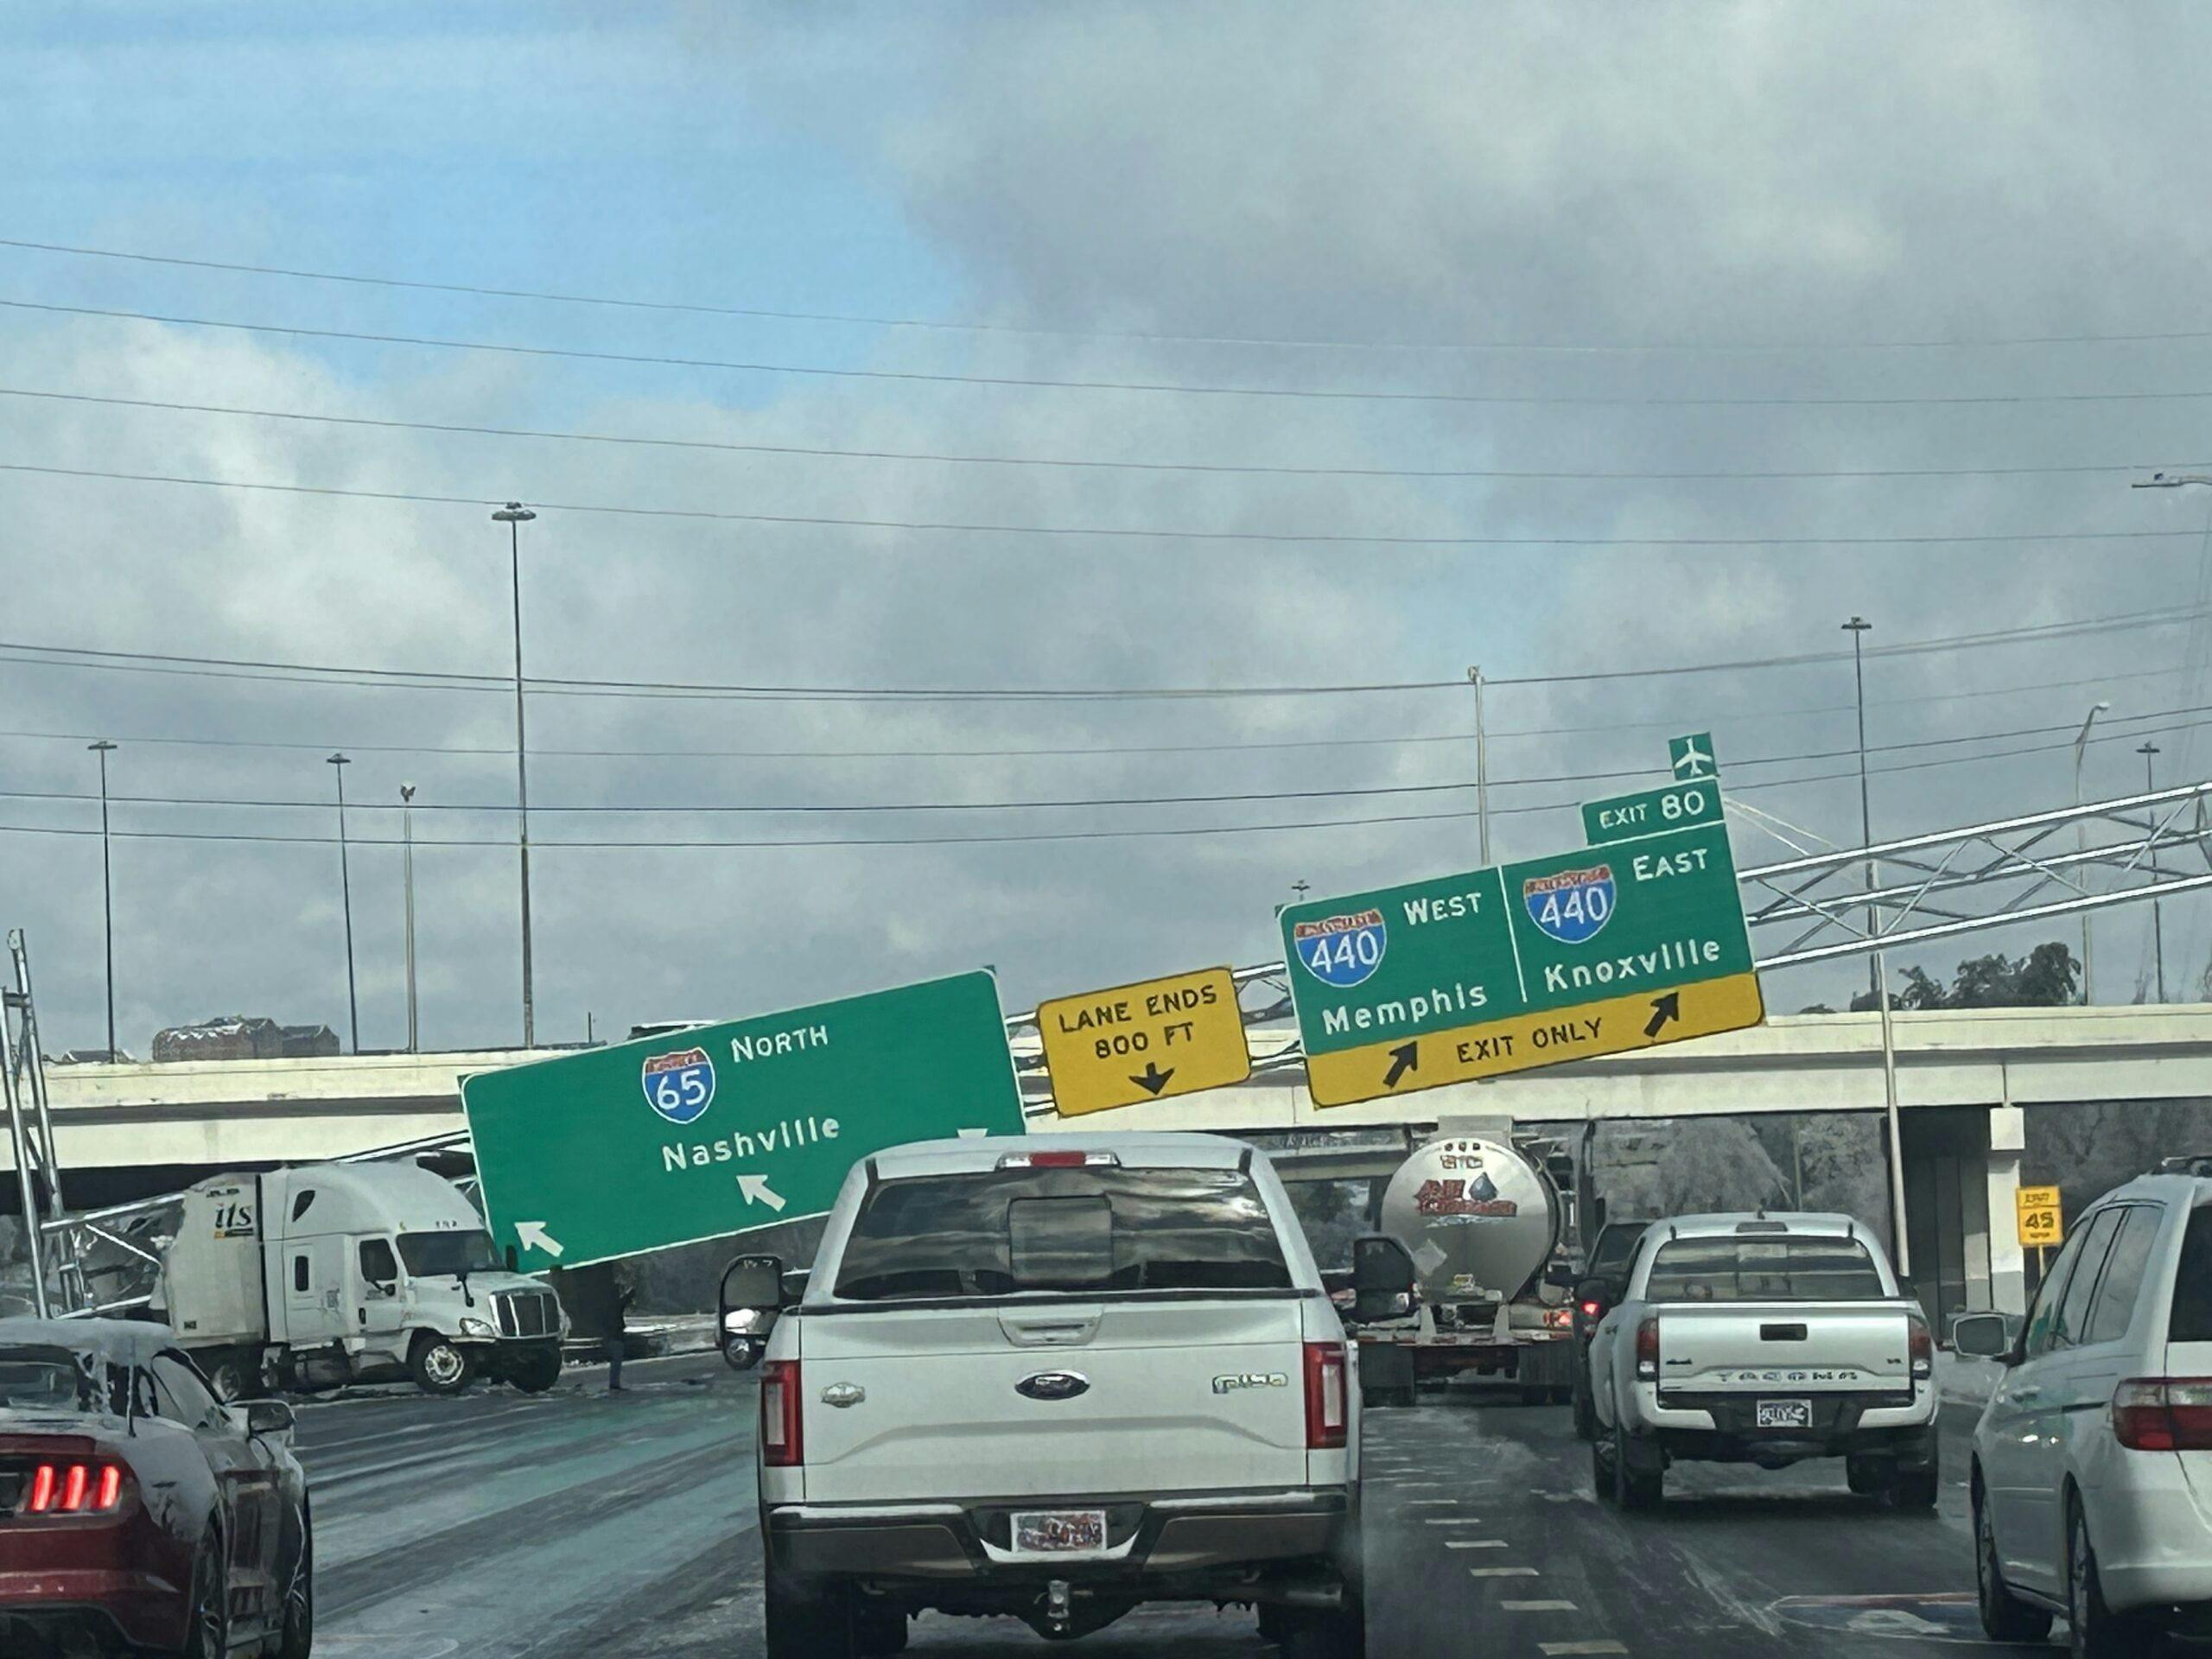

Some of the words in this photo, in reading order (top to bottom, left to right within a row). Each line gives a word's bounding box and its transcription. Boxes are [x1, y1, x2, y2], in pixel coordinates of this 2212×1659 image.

[1599, 803, 1647, 830] EXIT
[1660, 790, 1705, 820] 80
[1632, 848, 1708, 882] EAST
[1403, 892, 1482, 925] WEST
[1539, 886, 1608, 929] 440
[1310, 929, 1379, 974] 440
[1543, 938, 1721, 993] Knoxville
[1058, 1001, 1132, 1033] LANE
[1146, 984, 1217, 1017] ENDS
[1321, 982, 1488, 1035] Memphis
[730, 1025, 829, 1063] NORTH
[1094, 1032, 1149, 1059] 800
[1163, 1021, 1194, 1046] FT
[1456, 1036, 1515, 1064] EXIT
[1531, 1017, 1604, 1050] ONLY
[657, 1070, 706, 1110] 65
[661, 1116, 841, 1172] Nashville
[2025, 1211, 2055, 1229] 45
